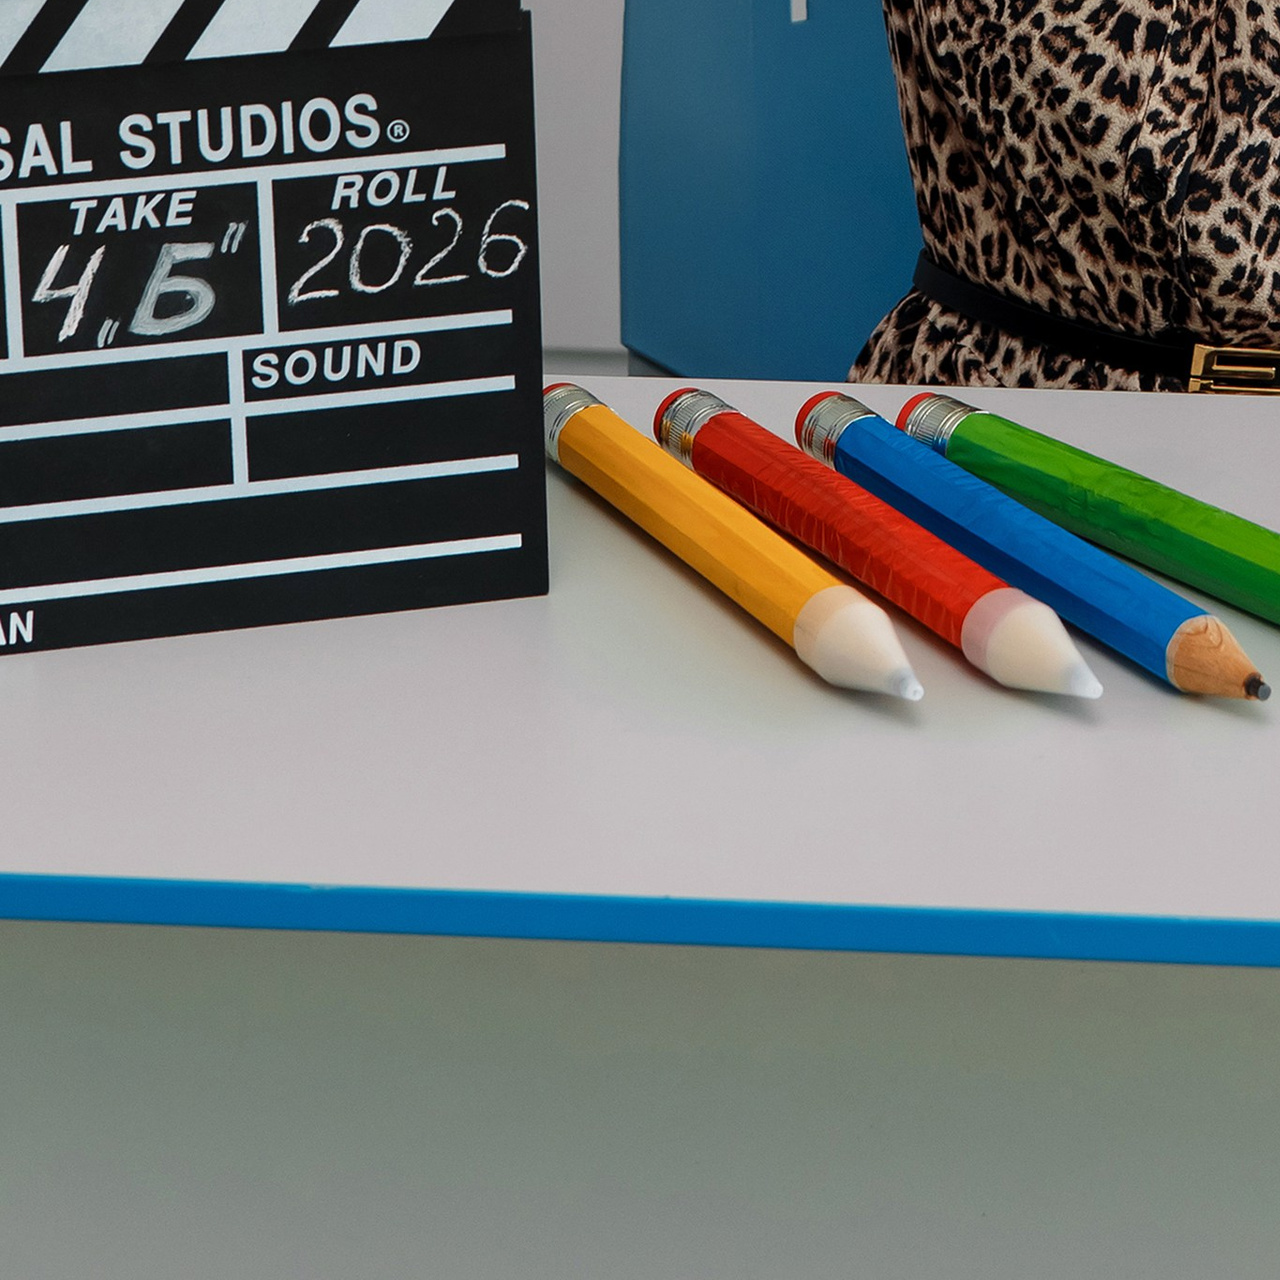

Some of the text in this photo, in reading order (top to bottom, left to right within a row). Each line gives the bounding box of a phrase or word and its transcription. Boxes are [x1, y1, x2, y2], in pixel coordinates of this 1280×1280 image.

[331, 166, 456, 211] ROLL
[69, 190, 196, 236] TAKE
[286, 198, 530, 306] 2026
[251, 339, 421, 389] SOUND
